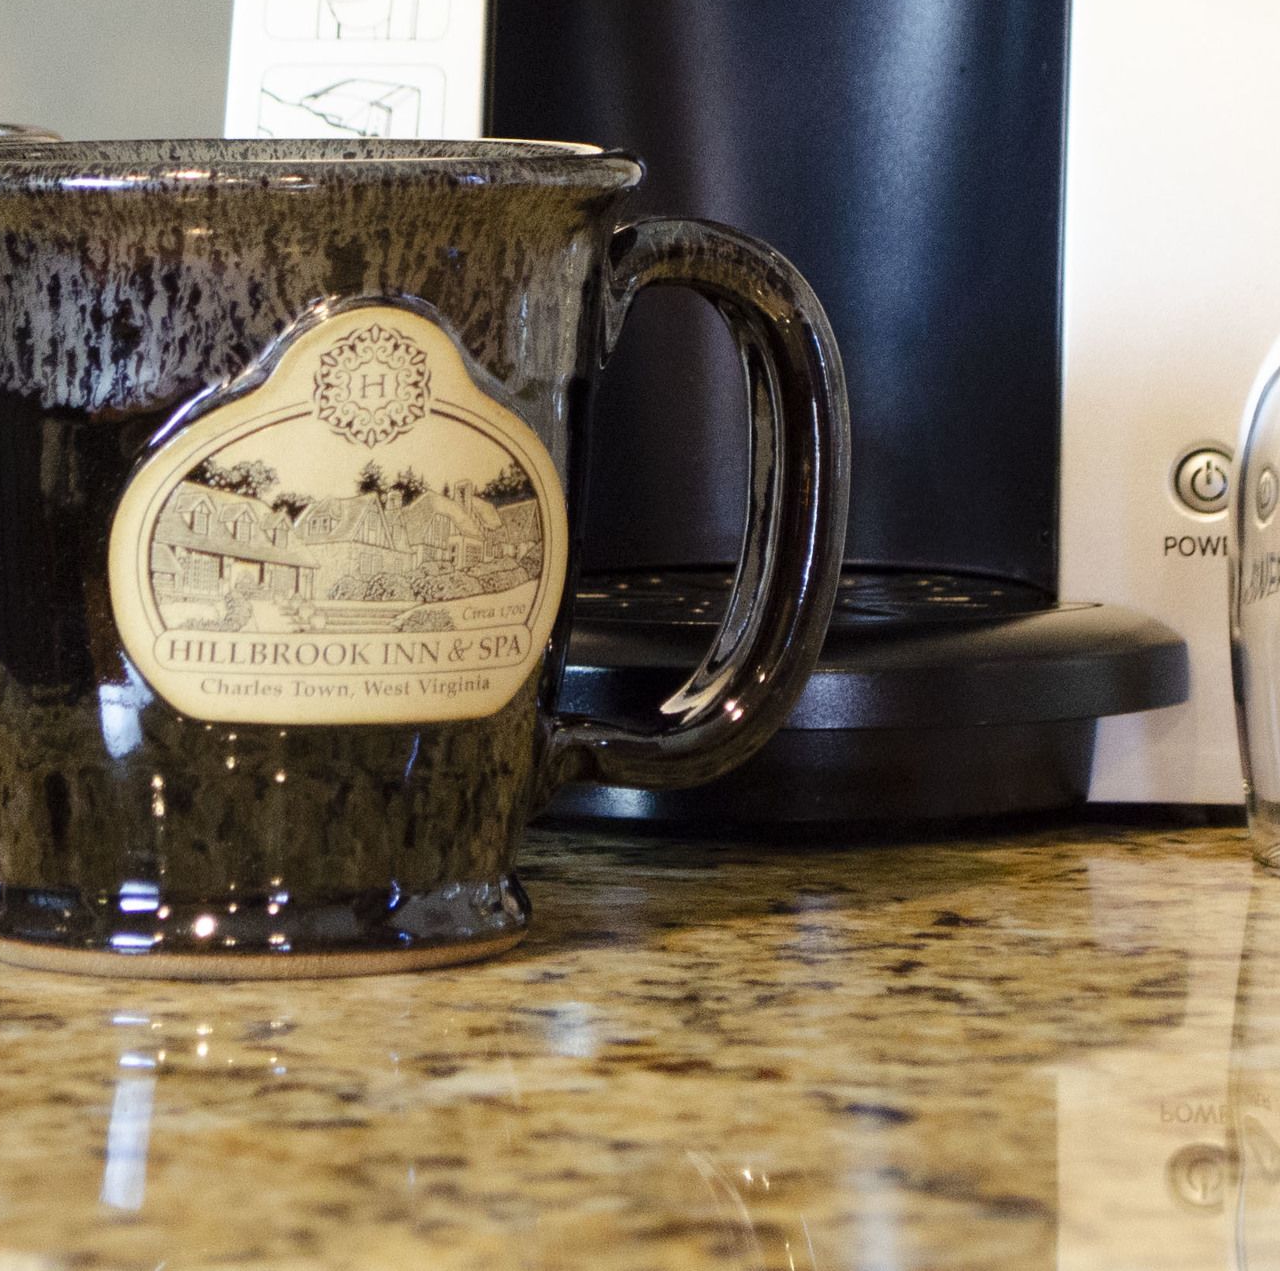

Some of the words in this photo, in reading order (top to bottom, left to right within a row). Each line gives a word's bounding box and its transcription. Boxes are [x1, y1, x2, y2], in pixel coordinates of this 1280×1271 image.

[359, 373, 388, 400] H
[462, 607, 496, 622] Circa
[500, 603, 527, 620] 1700
[168, 638, 372, 666] HILLBROOK
[382, 639, 441, 666] INN
[447, 637, 473, 661] &
[478, 633, 523, 660] SPA
[200, 677, 282, 697] Charles
[292, 678, 355, 699] Town,
[364, 677, 412, 695] West
[418, 674, 491, 695] Virginia
